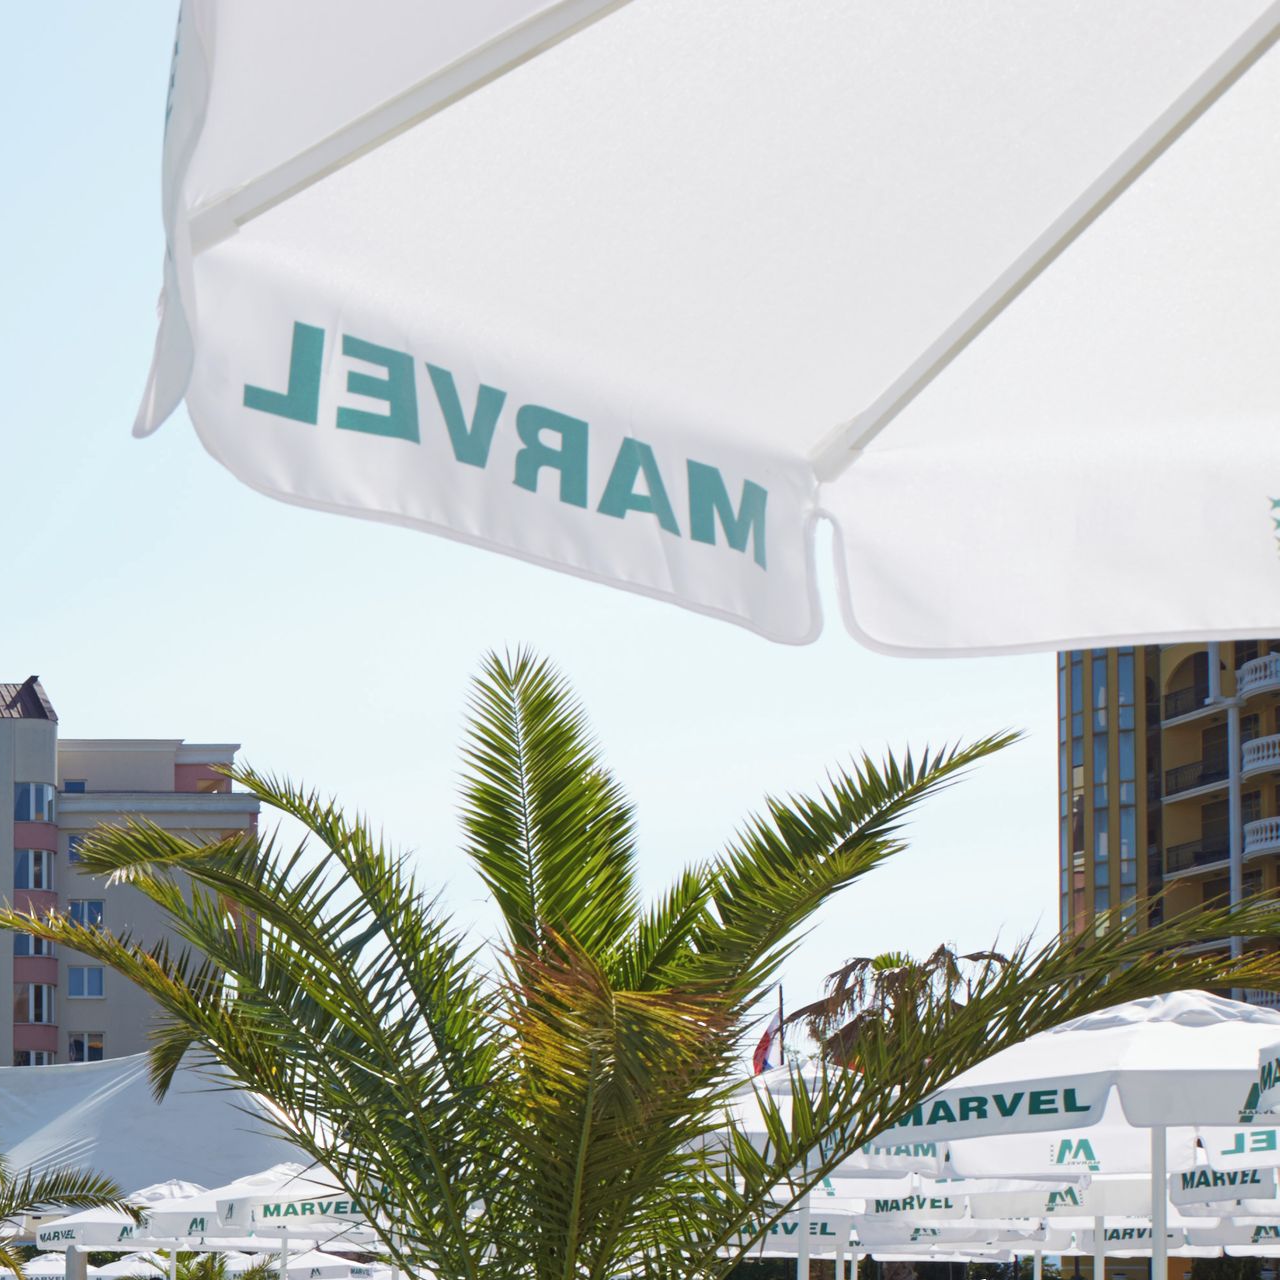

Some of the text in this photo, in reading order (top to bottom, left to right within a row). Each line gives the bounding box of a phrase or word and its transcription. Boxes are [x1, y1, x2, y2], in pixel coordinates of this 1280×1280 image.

[1181, 1168, 1261, 1191] MARVEL
[262, 1201, 362, 1218] MARVEL
[874, 1195, 953, 1213] MARVEL
[40, 1229, 76, 1243] MARVEL
[740, 1221, 836, 1236] ARVEL
